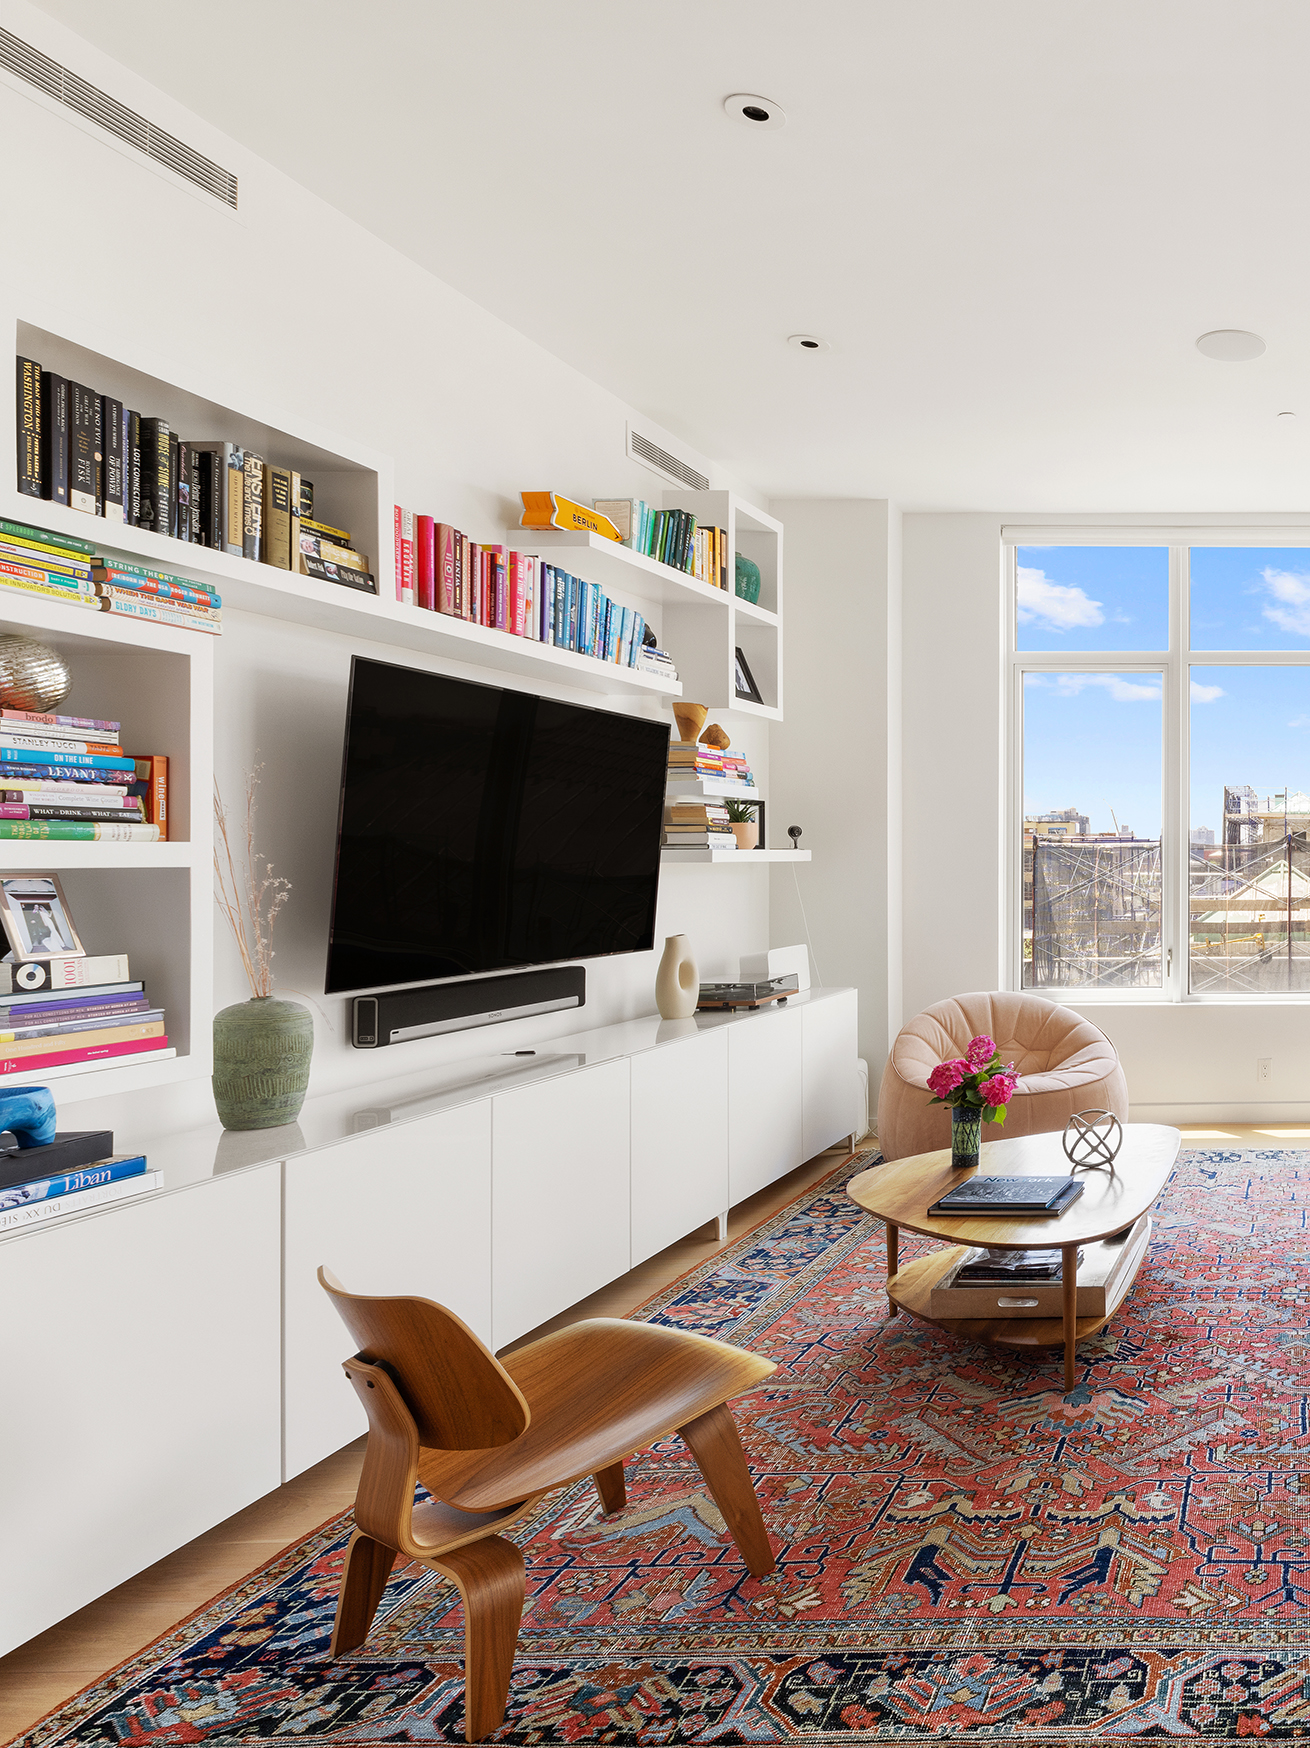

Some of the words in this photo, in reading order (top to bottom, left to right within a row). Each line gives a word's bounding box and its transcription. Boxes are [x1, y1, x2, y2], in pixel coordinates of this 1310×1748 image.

[23, 361, 34, 430] WASHINGTON
[95, 412, 101, 424] NO
[159, 433, 170, 456] HOUSE
[133, 448, 141, 466] LOST
[244, 457, 252, 472] The
[78, 458, 86, 482] FISK
[158, 467, 170, 489] STONE
[244, 471, 252, 486] Life
[133, 466, 141, 518] CONNECTIONS
[244, 486, 252, 500] and
[251, 457, 264, 529] EINSTEIN
[244, 501, 252, 526] Times
[5, 523, 34, 537] SPLENDOR
[572, 514, 598, 531] BERLIN
[0, 565, 44, 579] NSTRUCTION
[107, 560, 140, 574] STRING
[143, 568, 174, 582] THEORY
[9, 579, 51, 594] INNOVATOR'S
[52, 589, 81, 601] SOLUTION
[146, 580, 157, 589] THE
[158, 583, 169, 591] USA
[171, 586, 188, 597] ROGER
[115, 588, 139, 597] WHEN
[140, 593, 155, 601] THE
[155, 596, 176, 606] GAME
[176, 602, 193, 611] WAS
[193, 605, 209, 614] WAR
[115, 601, 138, 615] GLORY
[140, 607, 158, 618] DAYS
[25, 713, 54, 723] brodo
[13, 737, 49, 747] STANLEY
[51, 741, 77, 750] TUCCI
[89, 745, 110, 753] TASTE
[54, 754, 64, 762] ON
[65, 755, 78, 763] THE
[79, 756, 94, 765] LINE
[48, 766, 97, 779] LEVANT
[58, 795, 84, 803] Complete
[17, 821, 25, 839] WORLD
[24, 822, 32, 839] ATLAS
[33, 827, 40, 835] OF
[39, 822, 50, 839] WINE
[64, 961, 77, 986] 1001
[77, 959, 85, 985] ALBUMS
[18, 1042, 43, 1051] Hundred
[55, 1040, 67, 1048] Fifty
[64, 1170, 112, 1193] Liban
[65, 1188, 123, 1211] PORTRAITS
[44, 1203, 62, 1215] DU
[0, 1214, 19, 1228] SIÈ
